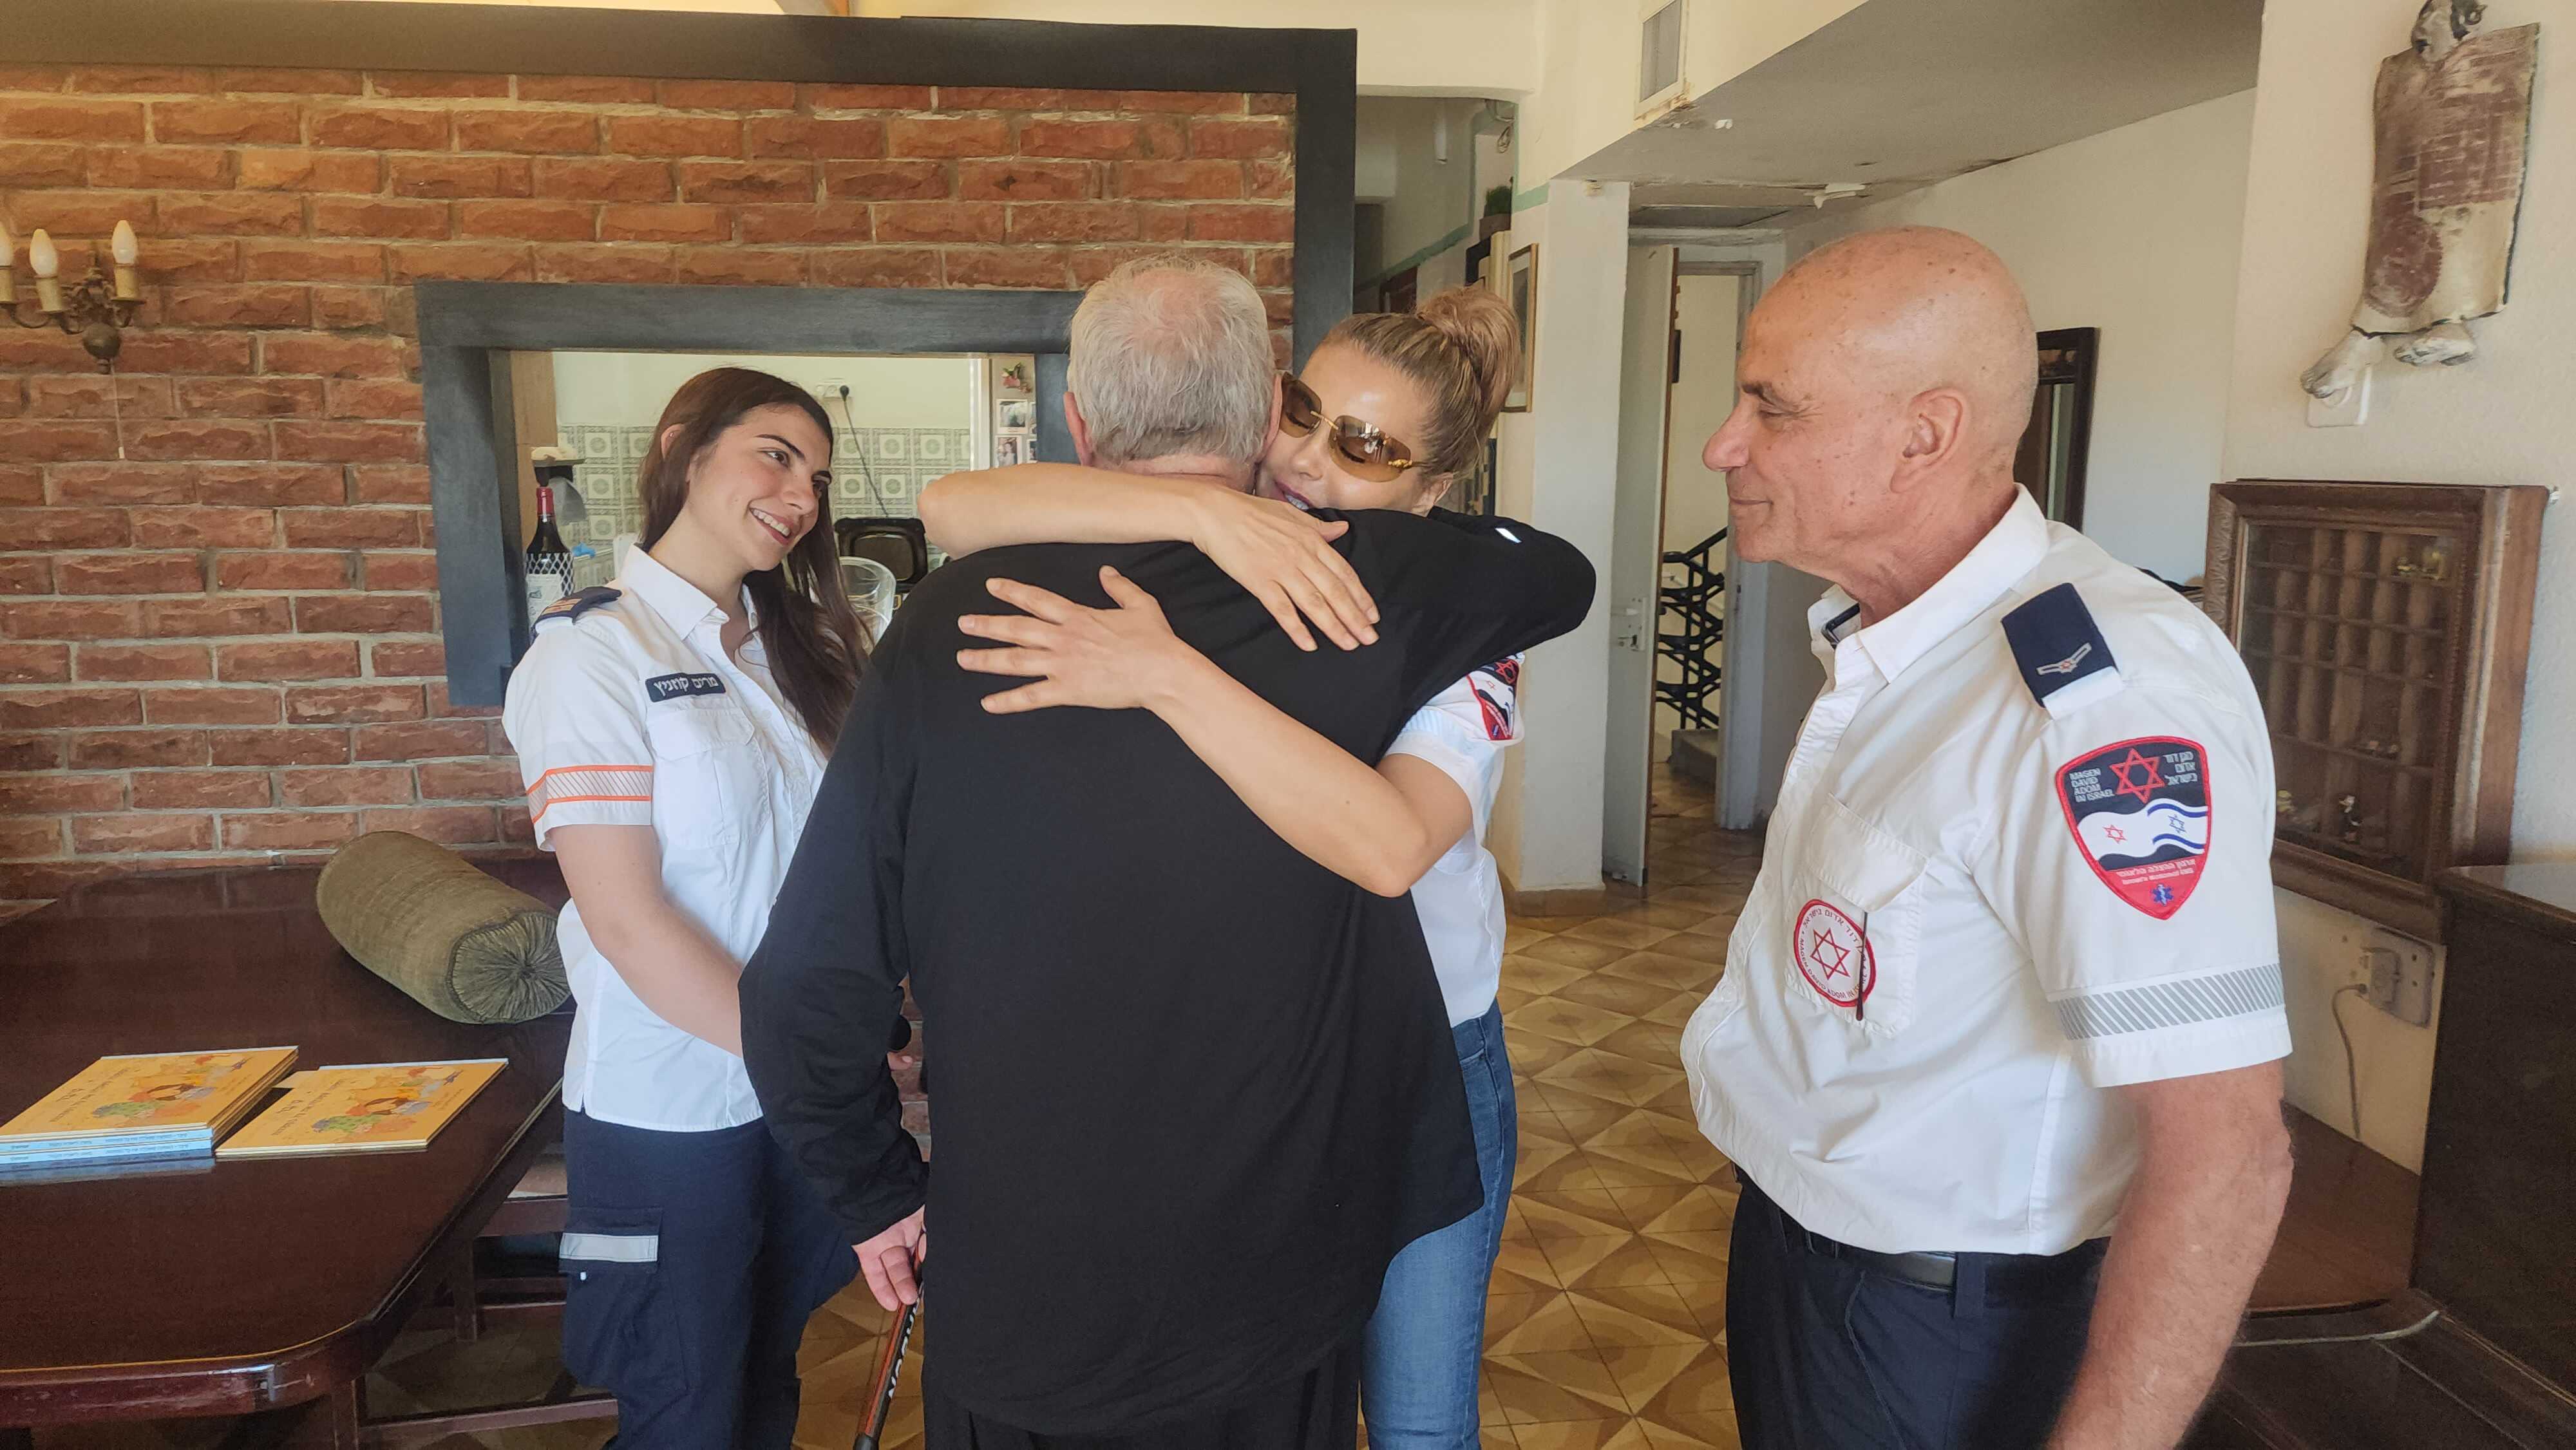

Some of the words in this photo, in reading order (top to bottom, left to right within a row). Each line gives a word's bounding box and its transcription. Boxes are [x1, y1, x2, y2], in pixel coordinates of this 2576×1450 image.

[692, 677, 719, 688] מרים
[2174, 762, 2195, 773] אדום
[2074, 784, 2101, 796] ADOM
[1824, 909, 1844, 926] אדום
[1846, 925, 1858, 941] דוד
